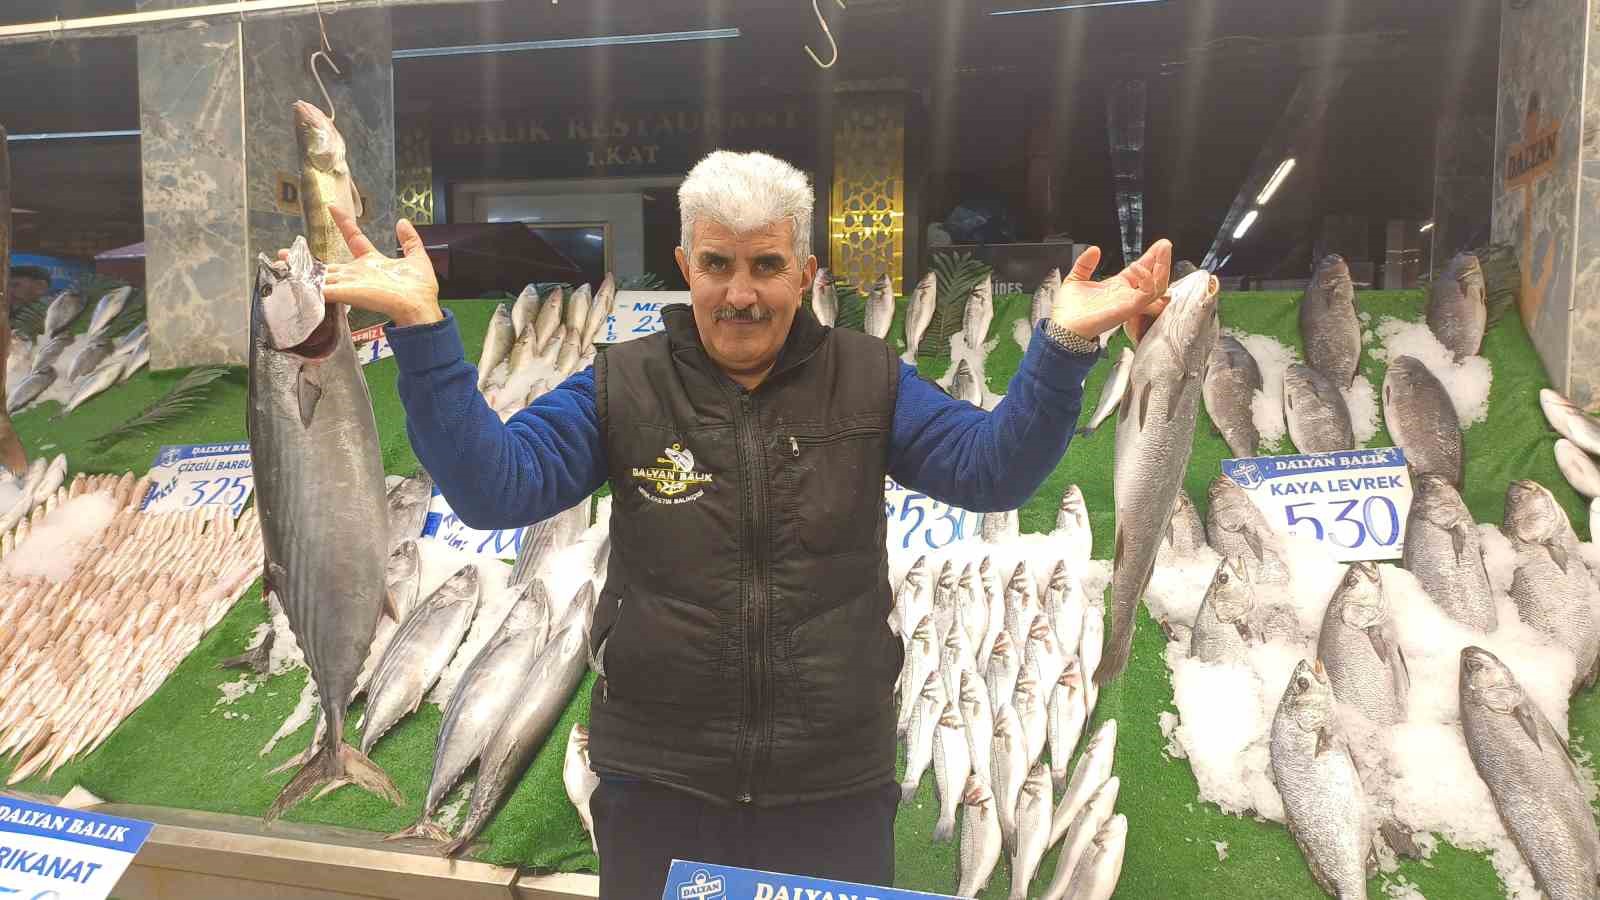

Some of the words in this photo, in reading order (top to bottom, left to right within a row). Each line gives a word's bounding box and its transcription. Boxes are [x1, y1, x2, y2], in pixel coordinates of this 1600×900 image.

[452, 120, 551, 145] BALIK
[1275, 458, 1335, 471] DALYAN
[1338, 453, 1389, 467] BALIK
[632, 467, 675, 481] DALYAN
[679, 471, 713, 481] BALIK
[184, 474, 253, 507] 325
[1270, 480, 1324, 497] KAYA
[1328, 475, 1404, 493] LEVREK
[1284, 495, 1400, 549] 530
[0, 805, 66, 832] DALYAN
[65, 818, 130, 842] BALIK
[682, 881, 721, 897] DALYAN
